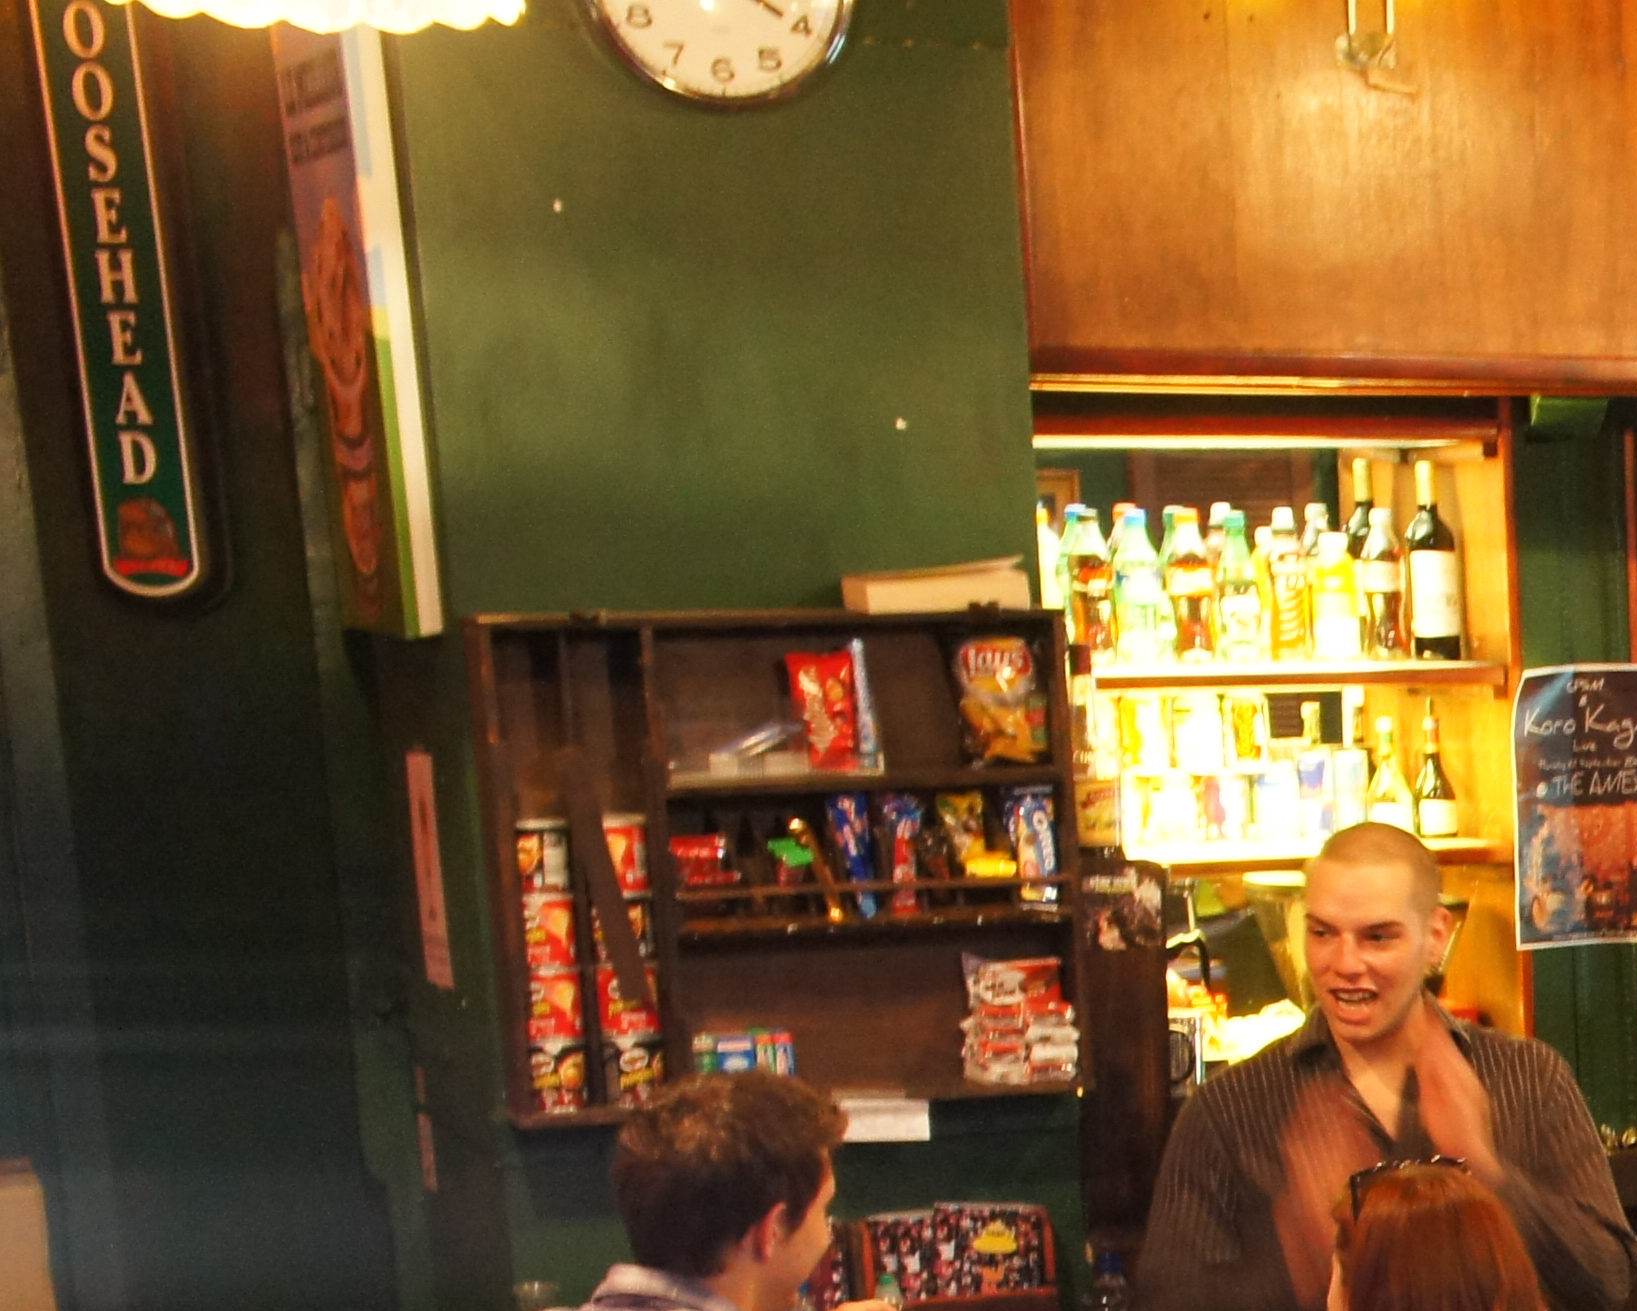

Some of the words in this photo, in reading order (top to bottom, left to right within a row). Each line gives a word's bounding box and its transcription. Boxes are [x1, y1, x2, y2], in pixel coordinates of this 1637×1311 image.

[662, 41, 685, 66] 7
[711, 57, 736, 83] 6
[1523, 706, 1577, 738] Koro
[1553, 770, 1585, 797] THE
